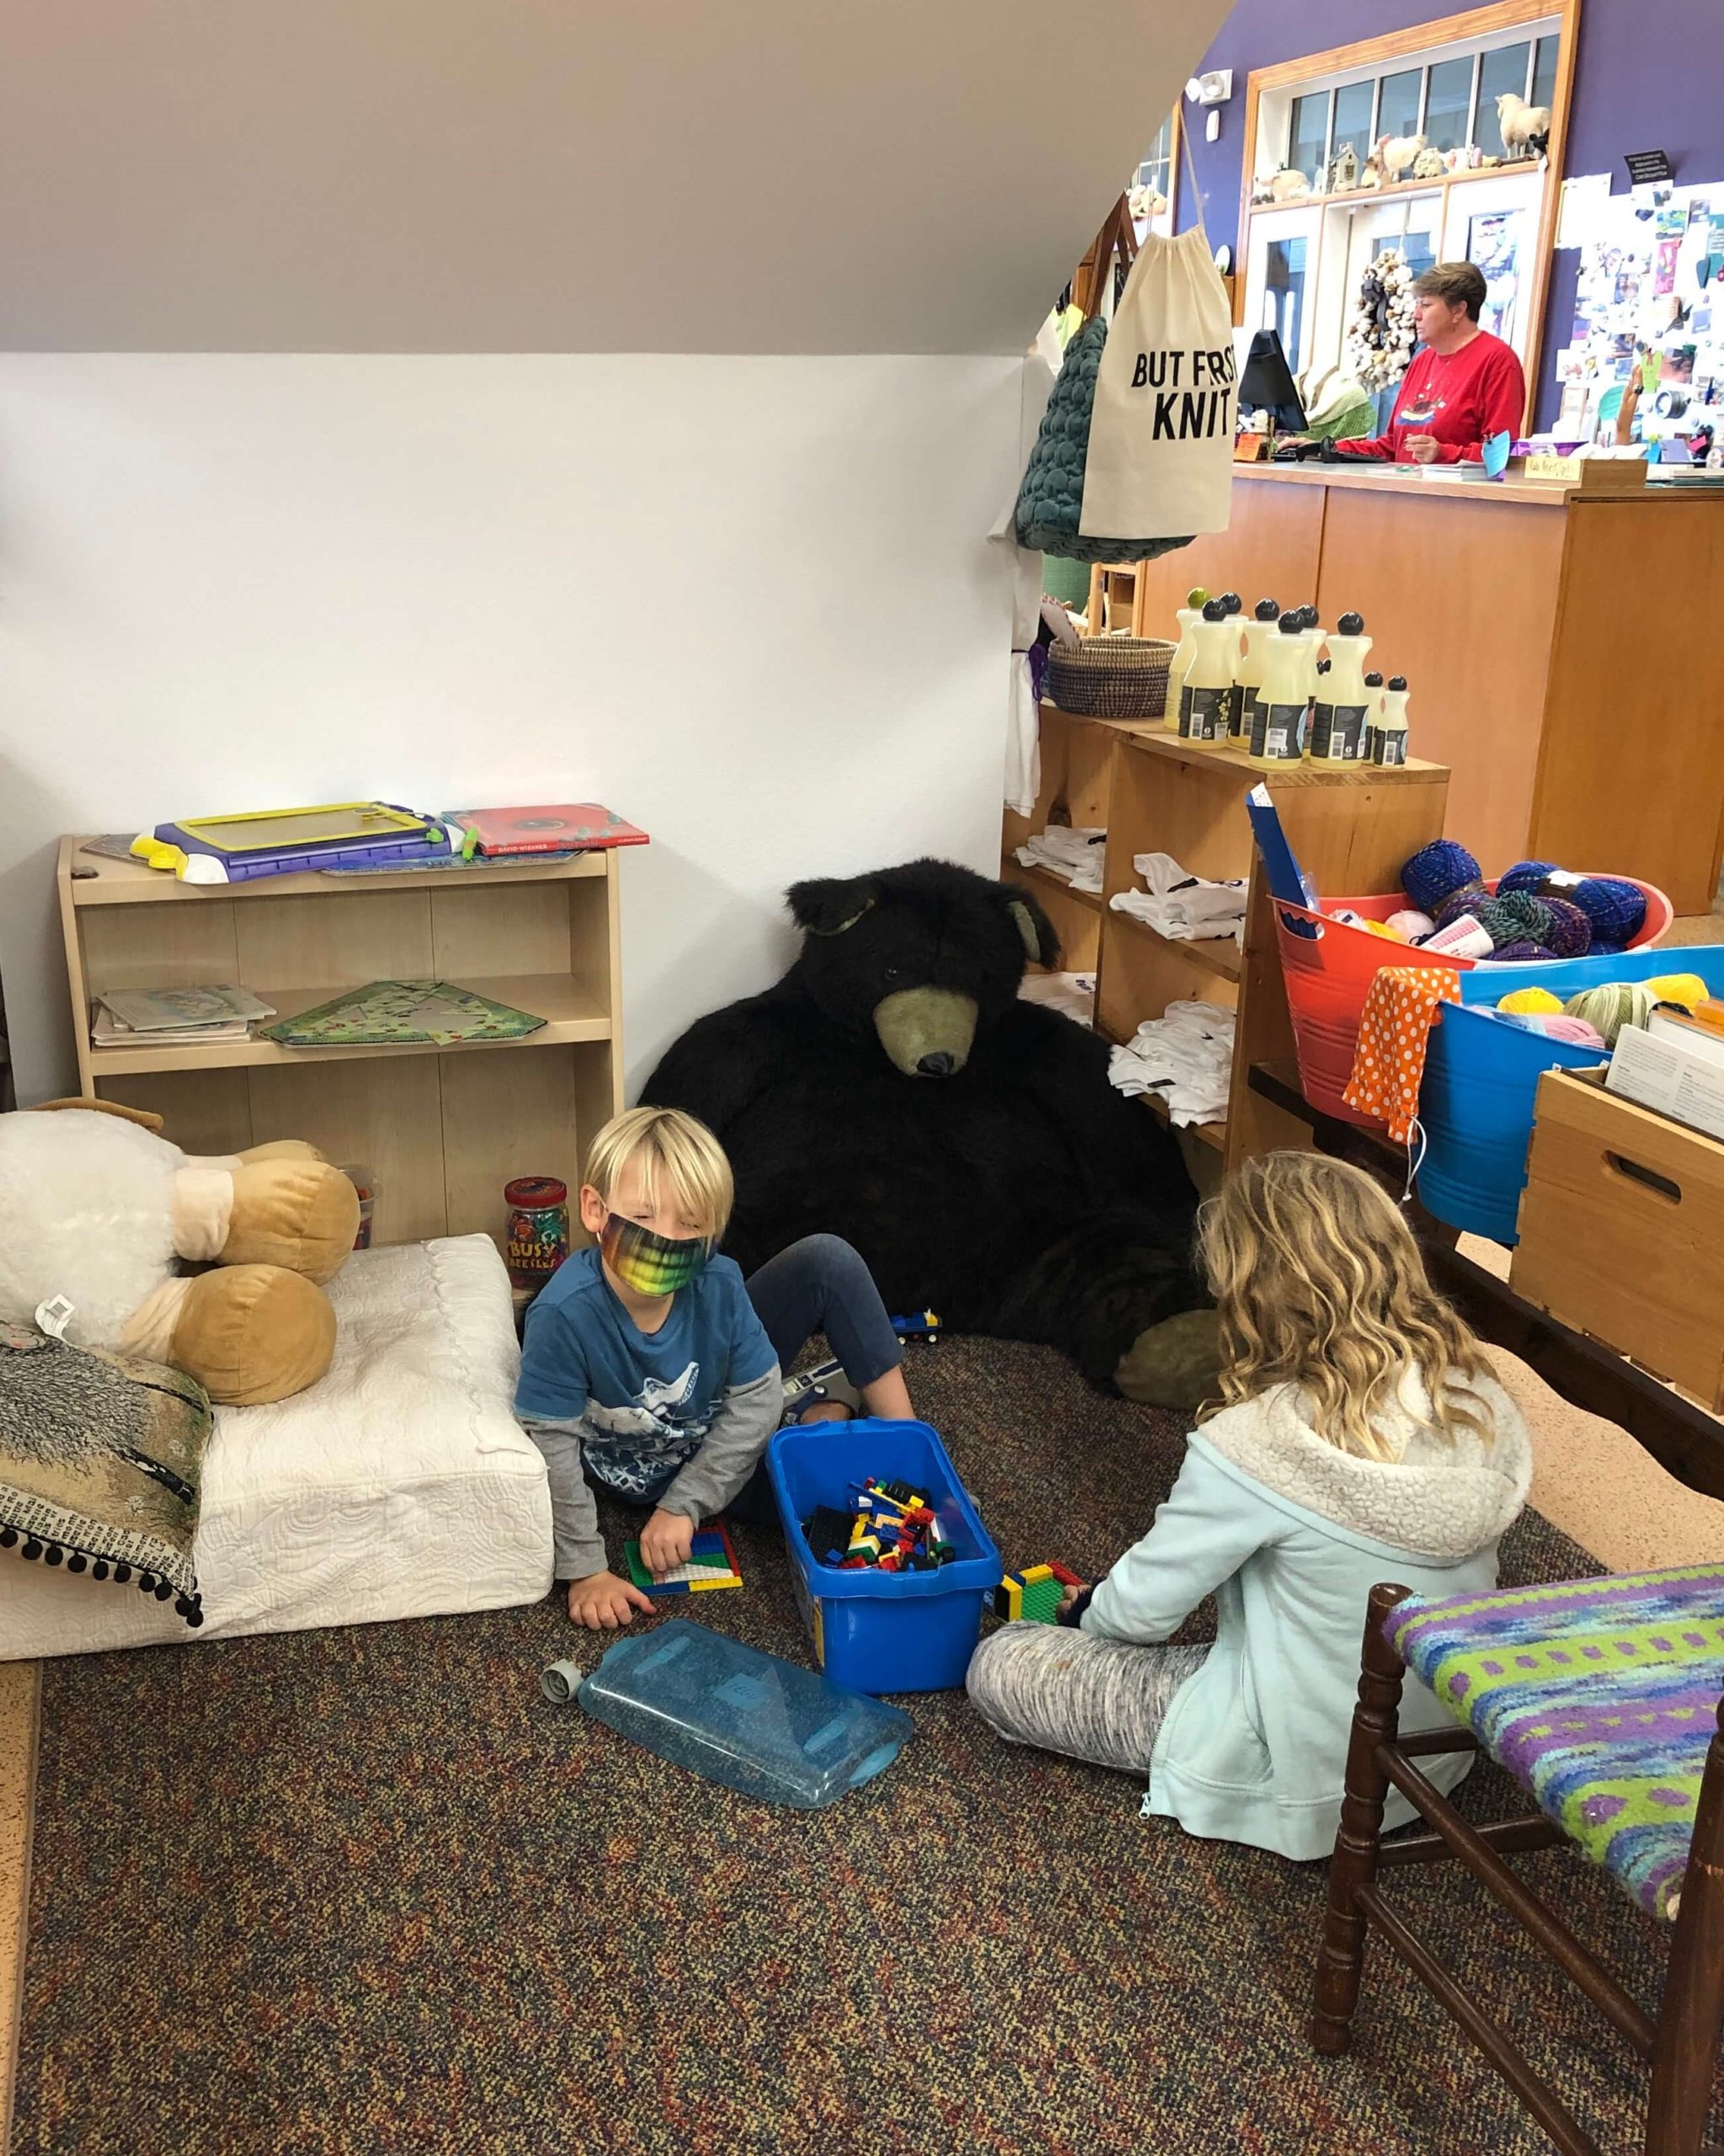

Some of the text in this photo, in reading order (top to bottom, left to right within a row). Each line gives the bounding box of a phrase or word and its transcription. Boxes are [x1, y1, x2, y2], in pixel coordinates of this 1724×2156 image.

[1131, 344, 1238, 387] BUT FRST
[1152, 387, 1231, 440] KNIT
[509, 1241, 557, 1258] BUSY
